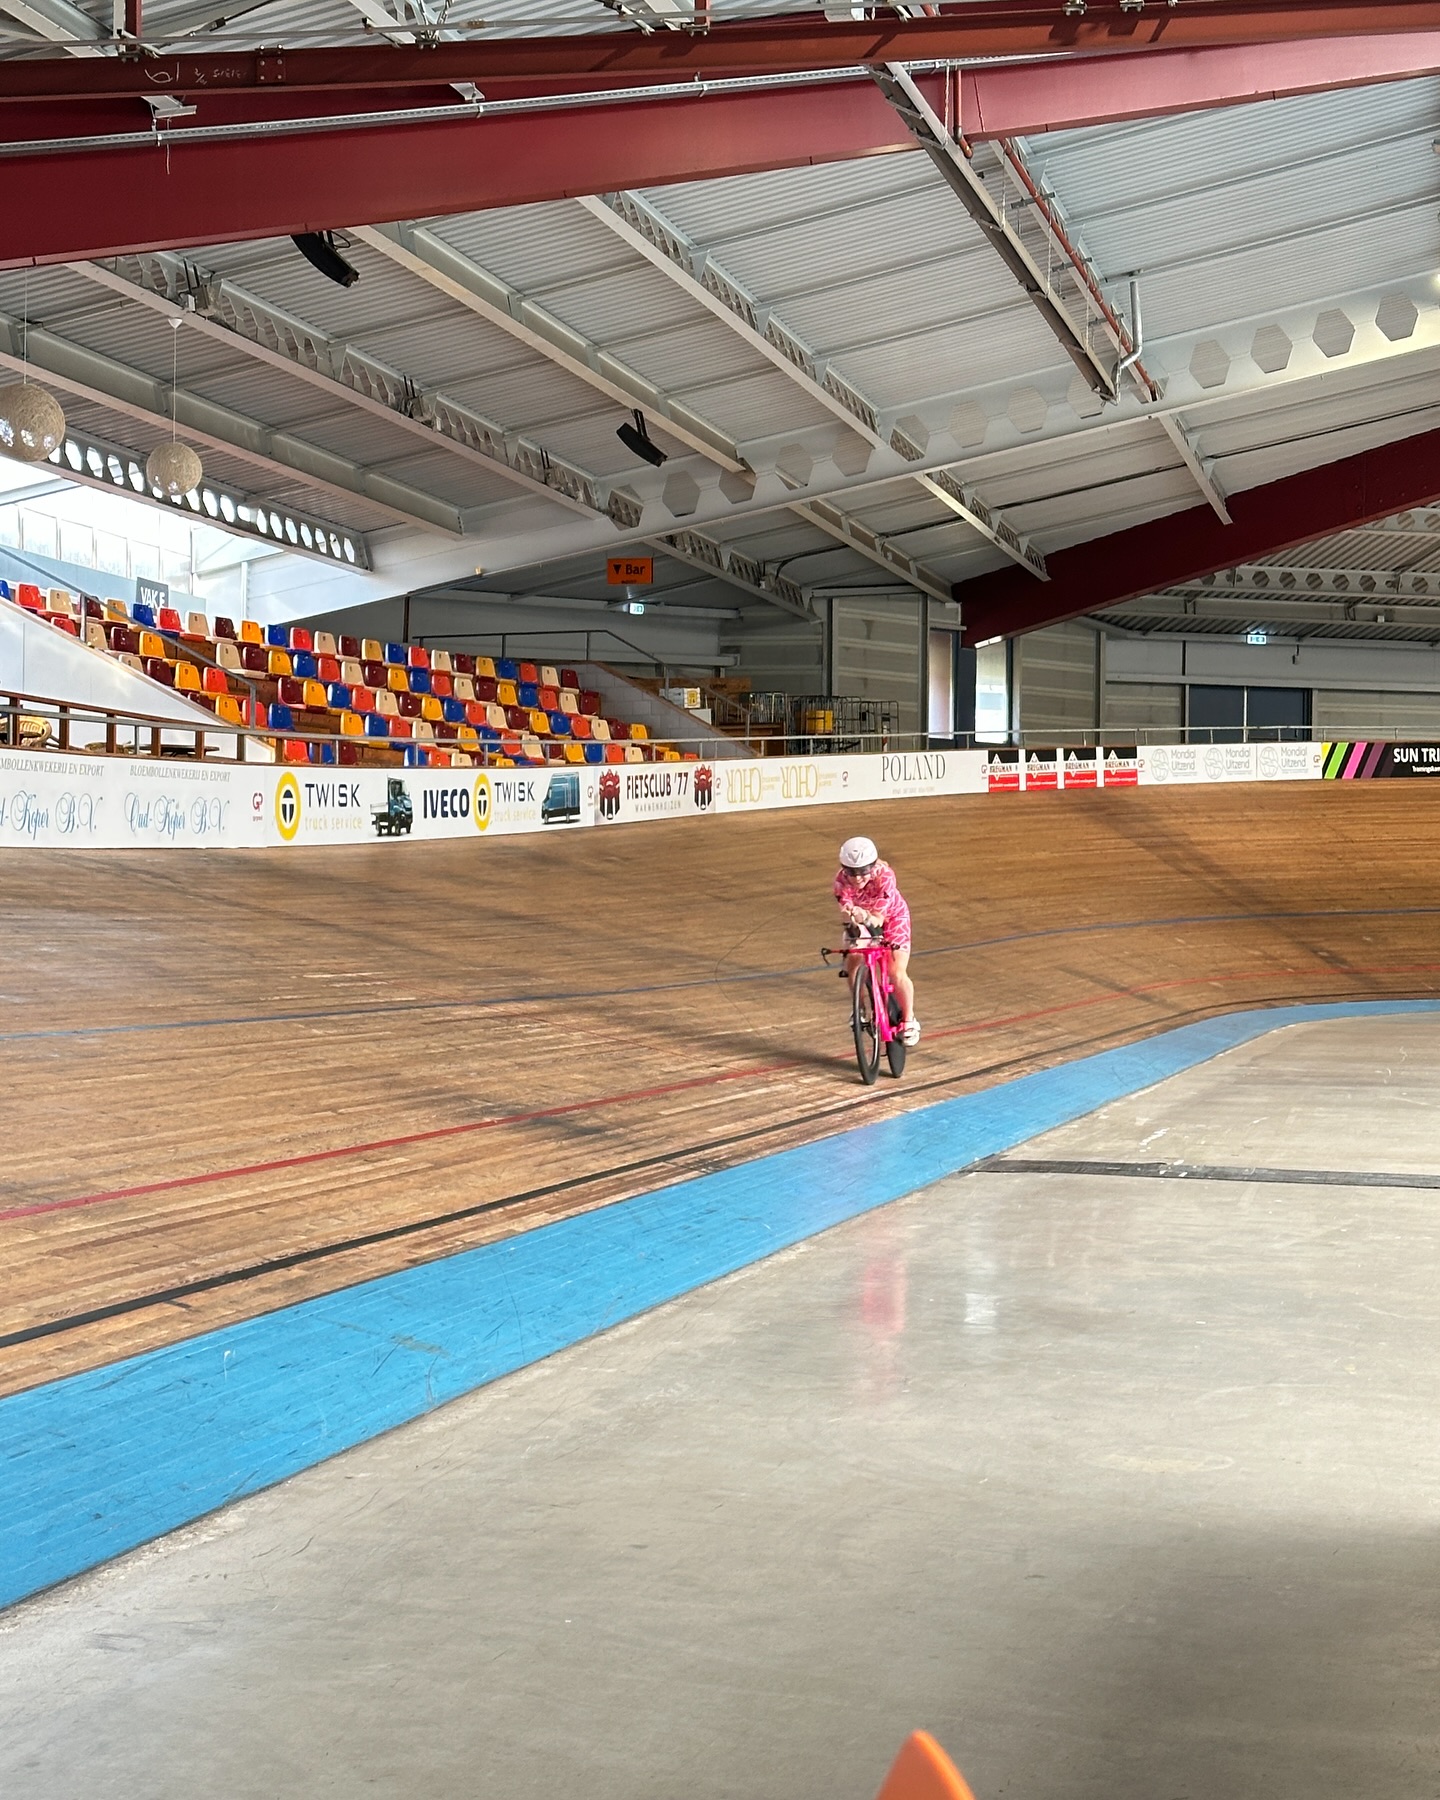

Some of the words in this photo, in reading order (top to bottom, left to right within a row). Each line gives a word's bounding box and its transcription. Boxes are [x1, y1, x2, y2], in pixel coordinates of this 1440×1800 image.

[625, 564, 646, 575] Bar
[140, 586, 158, 608] VAK
[1171, 749, 1196, 759] Mondial
[1225, 747, 1251, 758] Mondial
[1281, 746, 1307, 756] Mondial
[1393, 747, 1419, 763] SUN
[68, 762, 77, 775] EN
[79, 764, 104, 776] EXPORT
[881, 754, 946, 782] POLAND
[1171, 760, 1195, 770] Uitzend
[1226, 759, 1250, 769] Uitzend
[1281, 758, 1306, 768] Uitzend
[201, 770, 209, 781] EN
[209, 770, 231, 782] EXPORT
[494, 782, 535, 803] TWISK
[626, 773, 672, 800] FIETSCLUB
[305, 783, 361, 808] TWISK
[423, 788, 470, 819] IVECO
